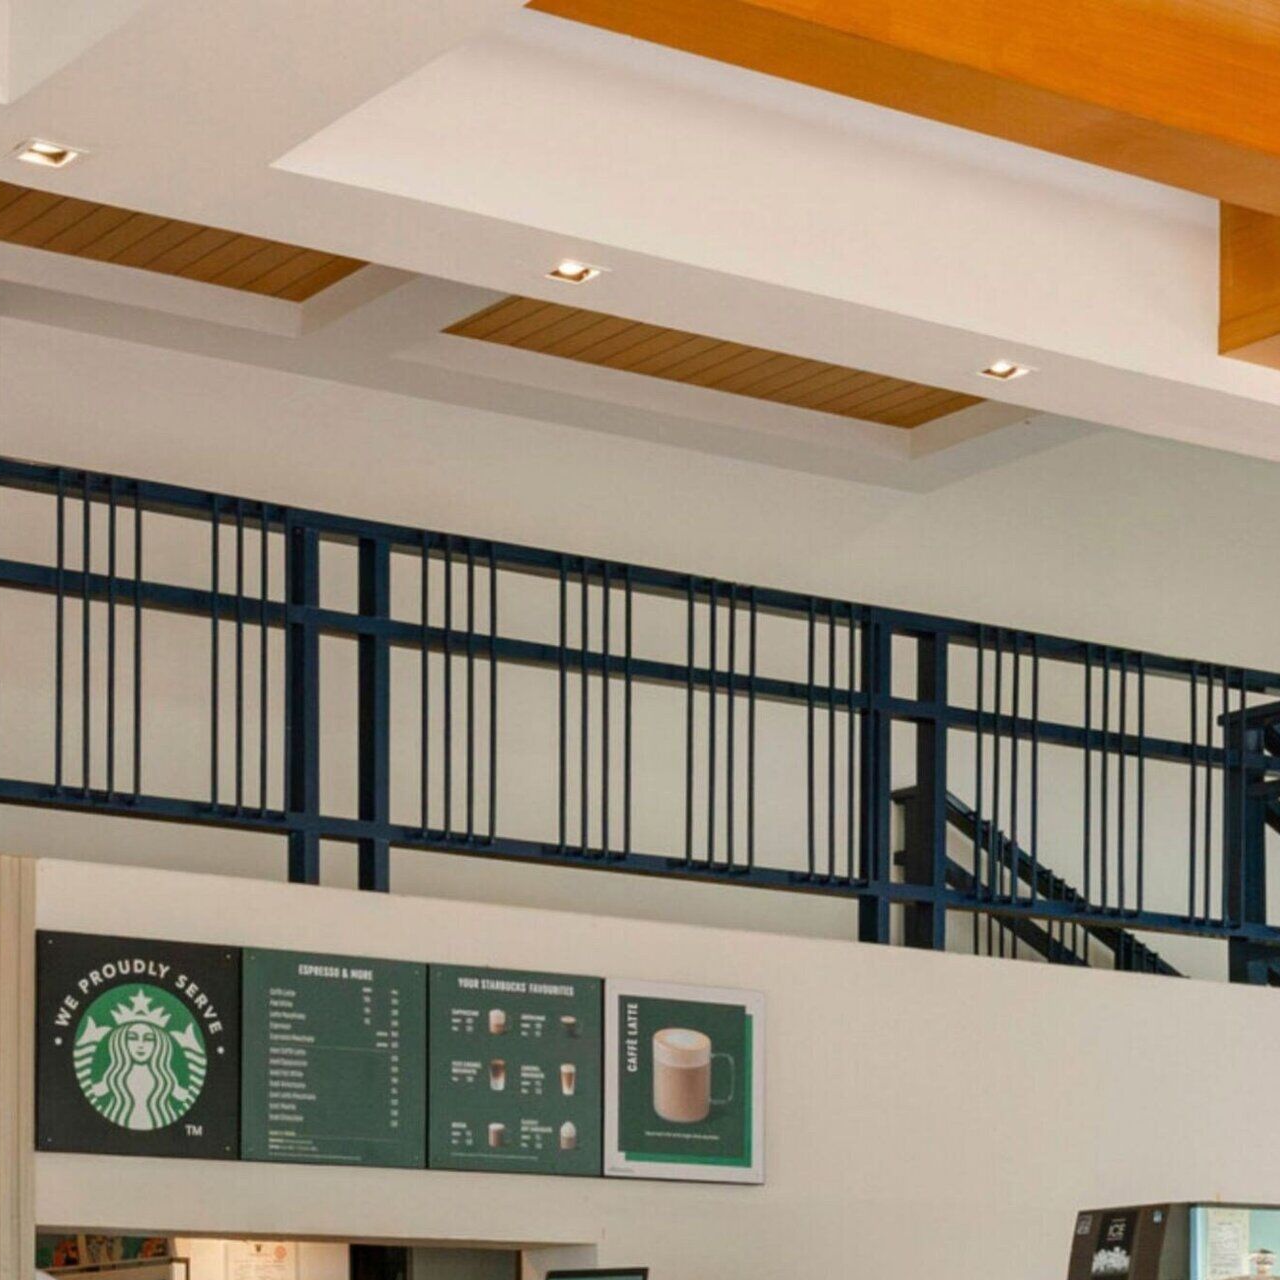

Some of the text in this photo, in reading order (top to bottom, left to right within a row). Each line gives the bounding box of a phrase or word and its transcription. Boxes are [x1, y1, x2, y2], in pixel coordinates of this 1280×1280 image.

[298, 964, 373, 981] ESPRESSO & MORE
[458, 977, 479, 989] YOUR
[55, 958, 223, 1035] WE PROUDLY SERVE
[626, 1003, 639, 1036] LATTE
[185, 1124, 203, 1136] TM
